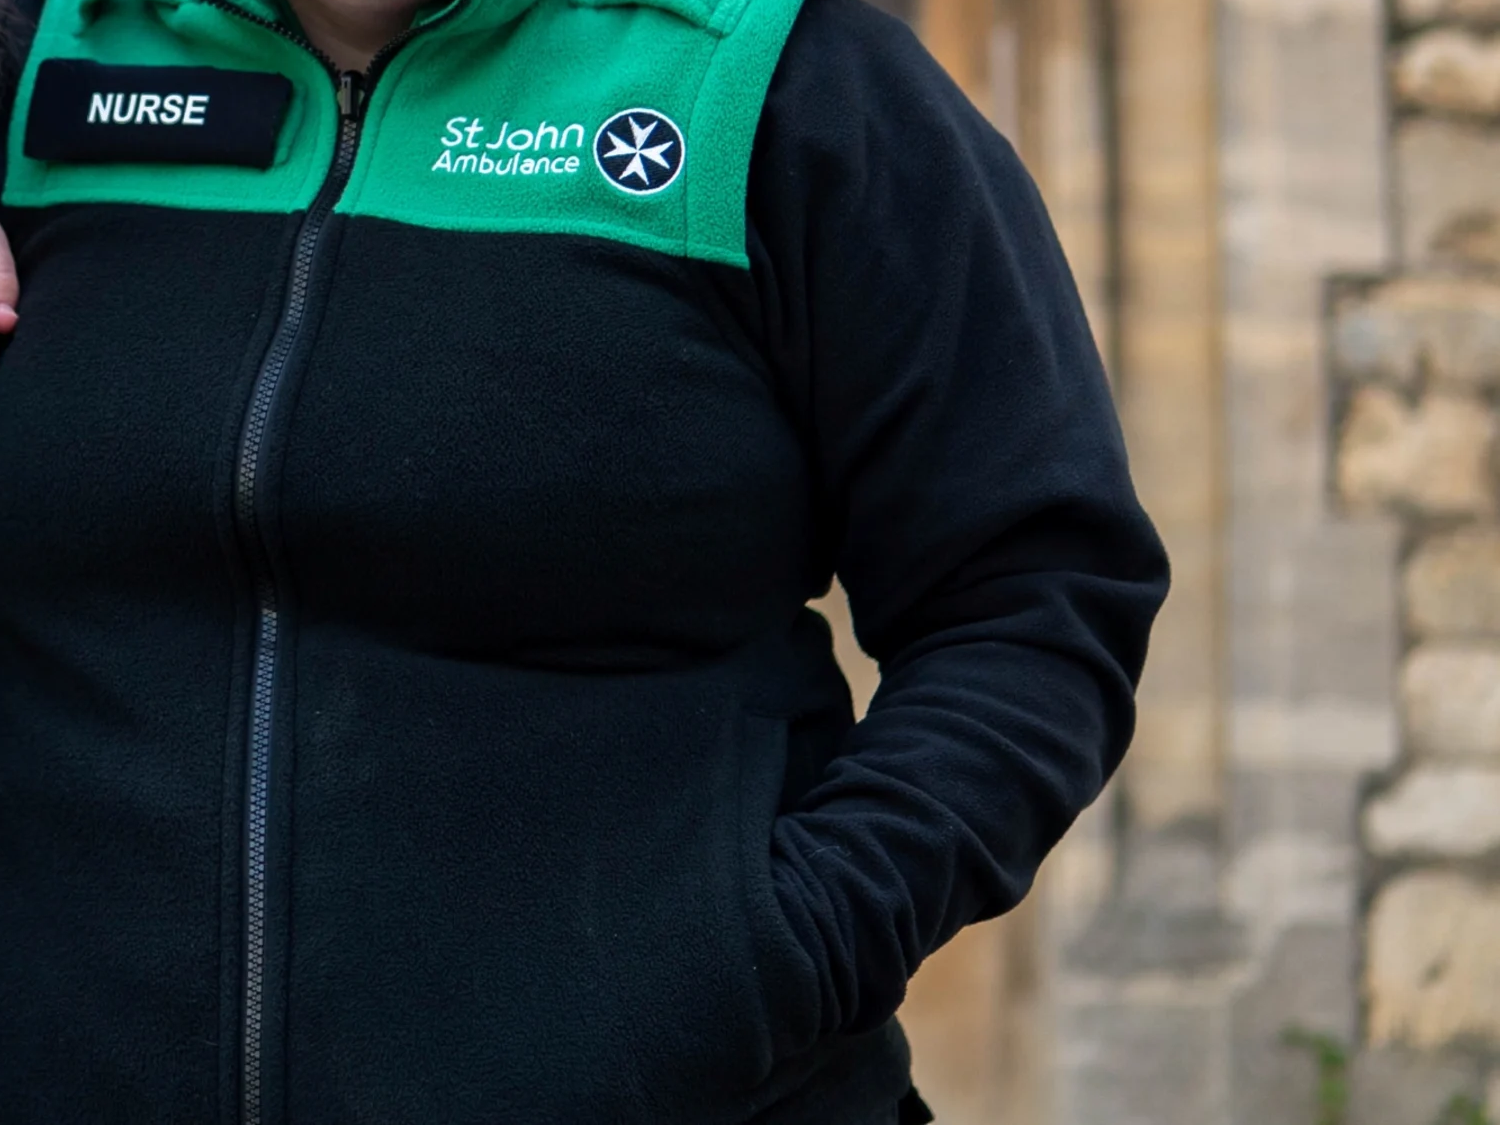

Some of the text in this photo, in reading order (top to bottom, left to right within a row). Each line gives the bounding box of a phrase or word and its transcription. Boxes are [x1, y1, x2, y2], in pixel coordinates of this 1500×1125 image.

[87, 92, 210, 125] NURSE
[440, 116, 585, 151] St John
[431, 149, 580, 175] Ambulance
